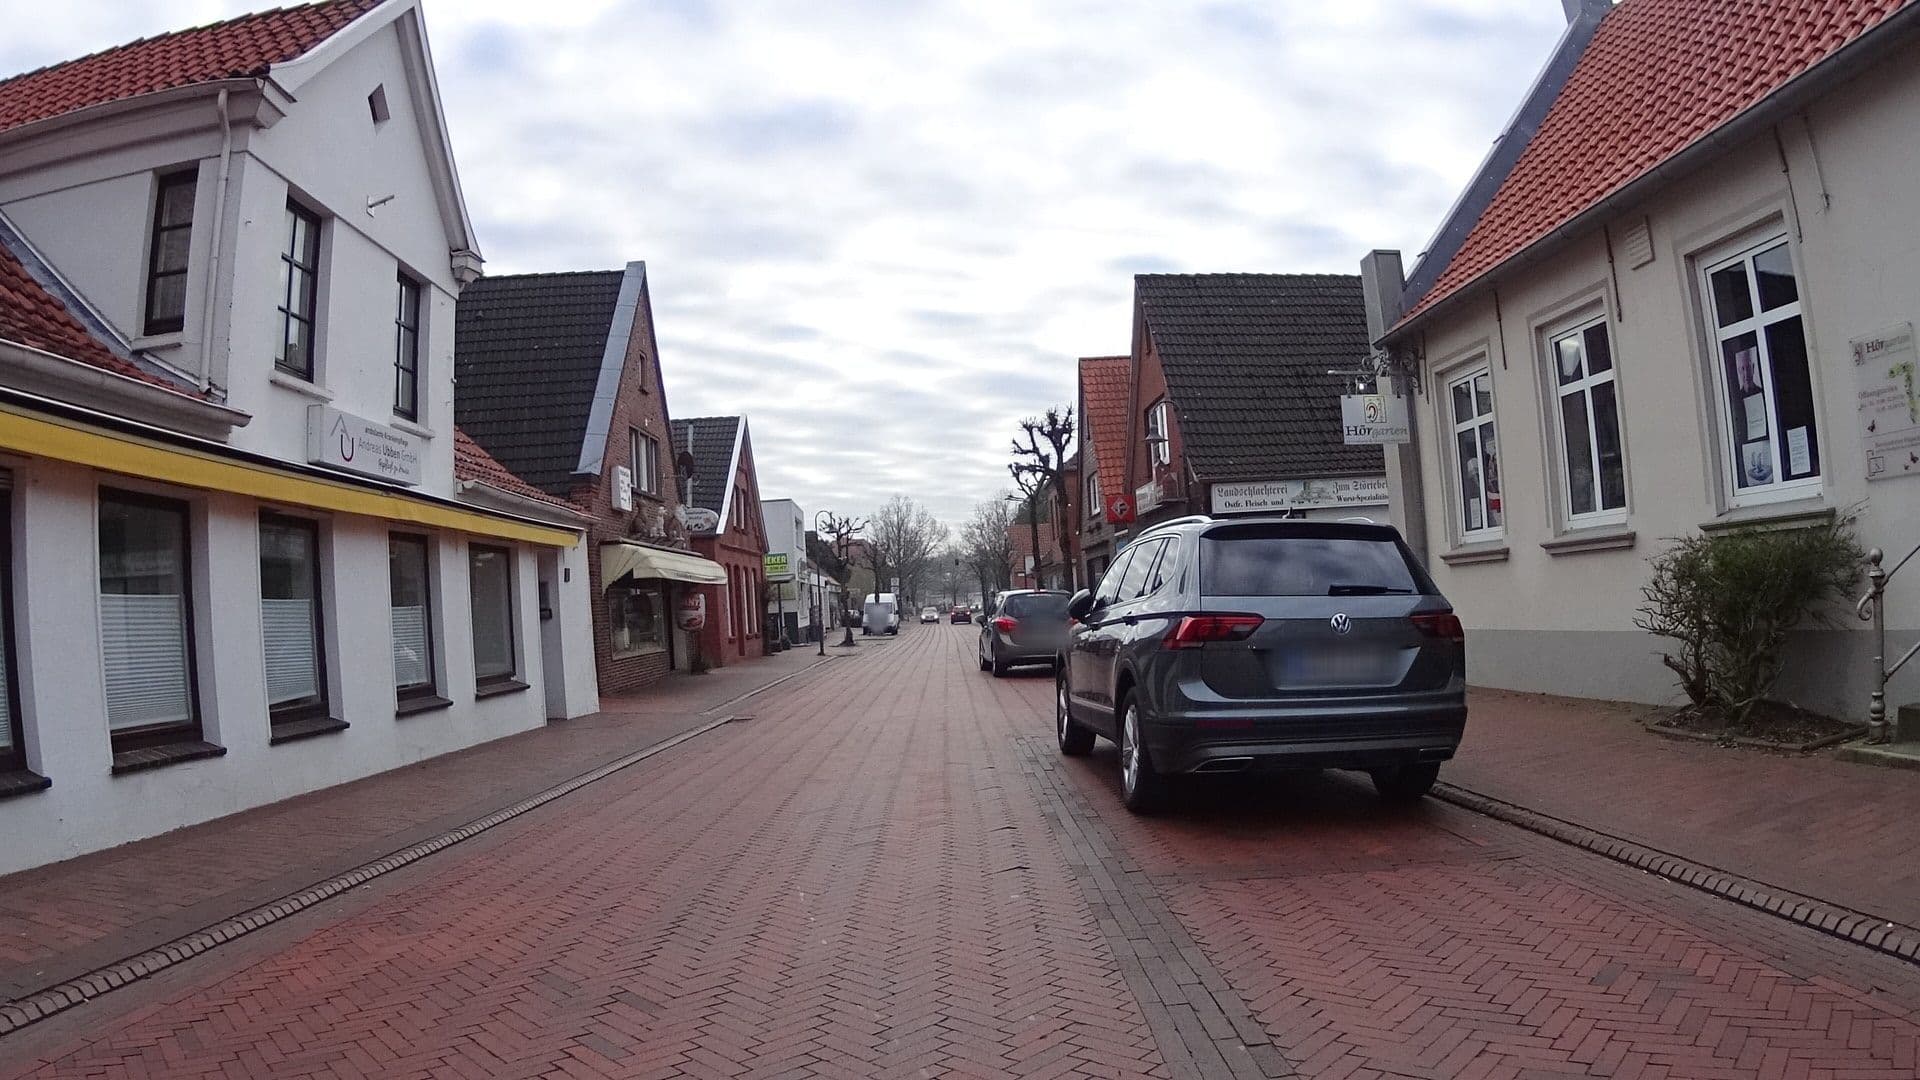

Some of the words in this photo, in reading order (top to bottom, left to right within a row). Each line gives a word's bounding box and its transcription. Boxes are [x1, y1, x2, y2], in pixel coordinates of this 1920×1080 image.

[1345, 424, 1408, 438] Hörgarten
[359, 437, 382, 455] Andreas
[382, 444, 401, 460] Ubben
[1217, 484, 1288, 498] Landschlachterei
[1332, 481, 1350, 494] Zum
[1245, 499, 1268, 508] Fleisch
[1270, 498, 1284, 506] und
